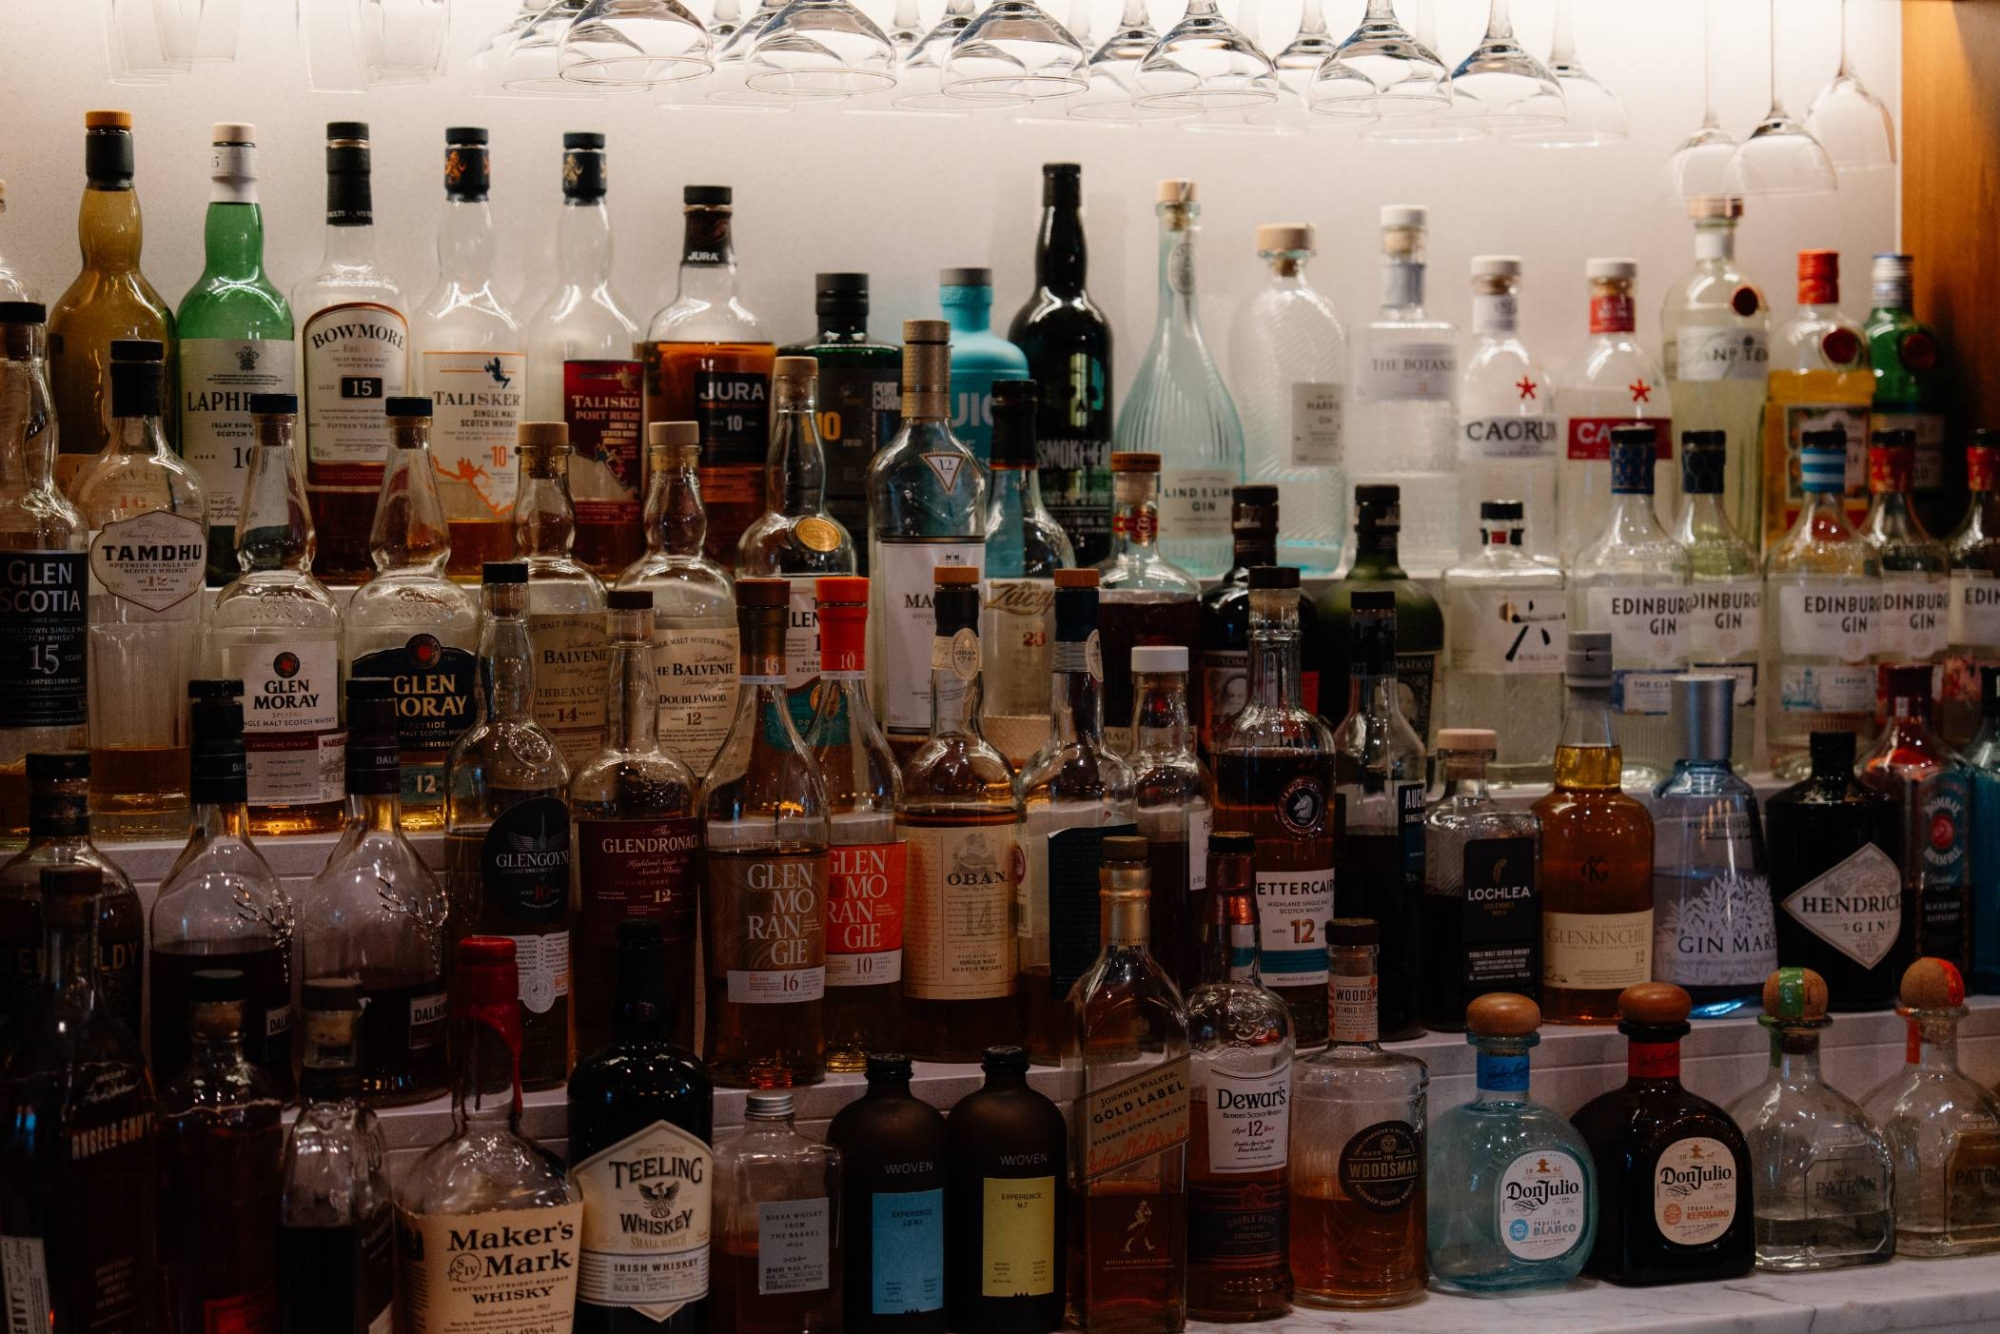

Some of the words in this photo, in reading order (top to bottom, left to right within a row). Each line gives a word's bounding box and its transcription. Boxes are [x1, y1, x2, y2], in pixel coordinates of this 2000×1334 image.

[688, 251, 719, 262] JURA
[352, 380, 373, 396] 15
[700, 381, 766, 401] JURA
[433, 391, 521, 407] TALISKER
[473, 410, 500, 418] SINGLE
[461, 419, 490, 427] SCOTCH
[727, 415, 743, 431] 10
[491, 445, 507, 467] 10
[940, 457, 954, 471] 12
[1164, 487, 1198, 498] LIND
[1192, 502, 1216, 512] GIN
[102, 544, 202, 562] TAMDHU
[7, 559, 73, 587] GLEN
[109, 562, 150, 570] SPEYSIDE
[0, 587, 82, 614] SCOTIA
[1611, 597, 1690, 616] EDINBURG
[1804, 596, 1881, 614] EDINBURG
[541, 619, 561, 631] MALT
[1649, 618, 1677, 636] GIN
[1714, 612, 1744, 631] GIN
[1841, 616, 1868, 634] GIN
[1909, 612, 1937, 630] GIN
[48, 634, 76, 642] WHISKY
[671, 637, 688, 645] MALT
[691, 636, 716, 645] SCOTCH
[1022, 631, 1046, 647] 23
[30, 644, 60, 675] 15
[544, 649, 609, 664] BALVENIE
[763, 656, 780, 673] 16
[840, 652, 856, 670] 10
[672, 662, 736, 676] BALVENIE
[264, 680, 310, 694] GLEN
[394, 673, 457, 695] GLEN
[253, 694, 319, 710] MORAY
[395, 695, 467, 718] ORAY
[659, 693, 727, 705] DOUBLEWOOD
[263, 719, 283, 728] MALT
[285, 718, 313, 728] SCOTCH
[314, 717, 336, 725] WHISKY
[557, 706, 578, 723] 14
[685, 712, 703, 726] 12
[419, 728, 447, 738] SCOTCH
[416, 775, 437, 794] 12
[1924, 796, 1961, 818] BOMBAY
[495, 849, 569, 869] GLENGOYN
[829, 849, 887, 875] GLEN
[747, 862, 814, 889] GLEN
[946, 871, 1007, 886] OBAN
[654, 887, 672, 903] 12
[845, 874, 888, 899] MO
[1257, 879, 1335, 896] ETTERCAIR
[1467, 885, 1532, 901] LOCHLEA
[772, 888, 815, 914] MO
[825, 899, 874, 924] RAN
[1280, 907, 1305, 915] SCOTCH
[747, 914, 801, 940] RAN
[1290, 918, 1316, 944] 12
[1852, 921, 1886, 933] GIN
[843, 923, 882, 949] GIE
[1677, 935, 1724, 954] GIN
[771, 939, 808, 966] GIE
[855, 956, 873, 975] 10
[952, 965, 979, 973] SCOTCH
[782, 972, 799, 992] 16
[1100, 1086, 1138, 1109] JOHNNIE
[1139, 1071, 1178, 1091] WALKER
[1216, 1086, 1286, 1111] Dewar's
[1093, 1102, 1134, 1124] GOLD
[1137, 1080, 1186, 1107] LABEL
[1223, 1111, 1247, 1120] BLENDED
[1247, 1110, 1267, 1119] SCOTCH
[1092, 1129, 1127, 1147] BLENDED
[1127, 1117, 1157, 1132] SCOTCH
[1159, 1104, 1188, 1120] WHISKY
[1231, 1126, 1247, 1135] Aged
[1247, 1119, 1264, 1138] 12
[885, 1160, 935, 1176] WOVEN
[999, 1152, 1049, 1167] WOVEN
[609, 1156, 703, 1190] TEELING
[1349, 1159, 1418, 1179] WOODSMAN
[1001, 1192, 1043, 1202] EXPERIENCE
[1016, 1201, 1028, 1209] N.7
[1379, 1197, 1401, 1207] SCOTCH
[620, 1208, 694, 1236] WHISKEY
[766, 1213, 791, 1221] NIKKA
[794, 1211, 823, 1219] WHISKY
[891, 1208, 933, 1219] EXPERIENCE
[1686, 1209, 1731, 1220] REPOSADO
[784, 1222, 806, 1230] FROM
[1533, 1219, 1561, 1227] TEQUILA
[1533, 1223, 1577, 1237] BLANCO
[446, 1220, 574, 1251] Maker's
[788, 1229, 821, 1239] BARREL
[630, 1238, 660, 1251] SMALL
[661, 1236, 687, 1249] BATCH
[482, 1249, 573, 1278] Mark
[614, 1262, 649, 1273] IRISH
[651, 1258, 699, 1272] WHISKEY
[452, 1283, 494, 1292] KENTUCKY
[496, 1279, 534, 1289] STRAIGHT
[536, 1274, 570, 1286] BOURBON
[471, 1285, 556, 1304] WHISKY
